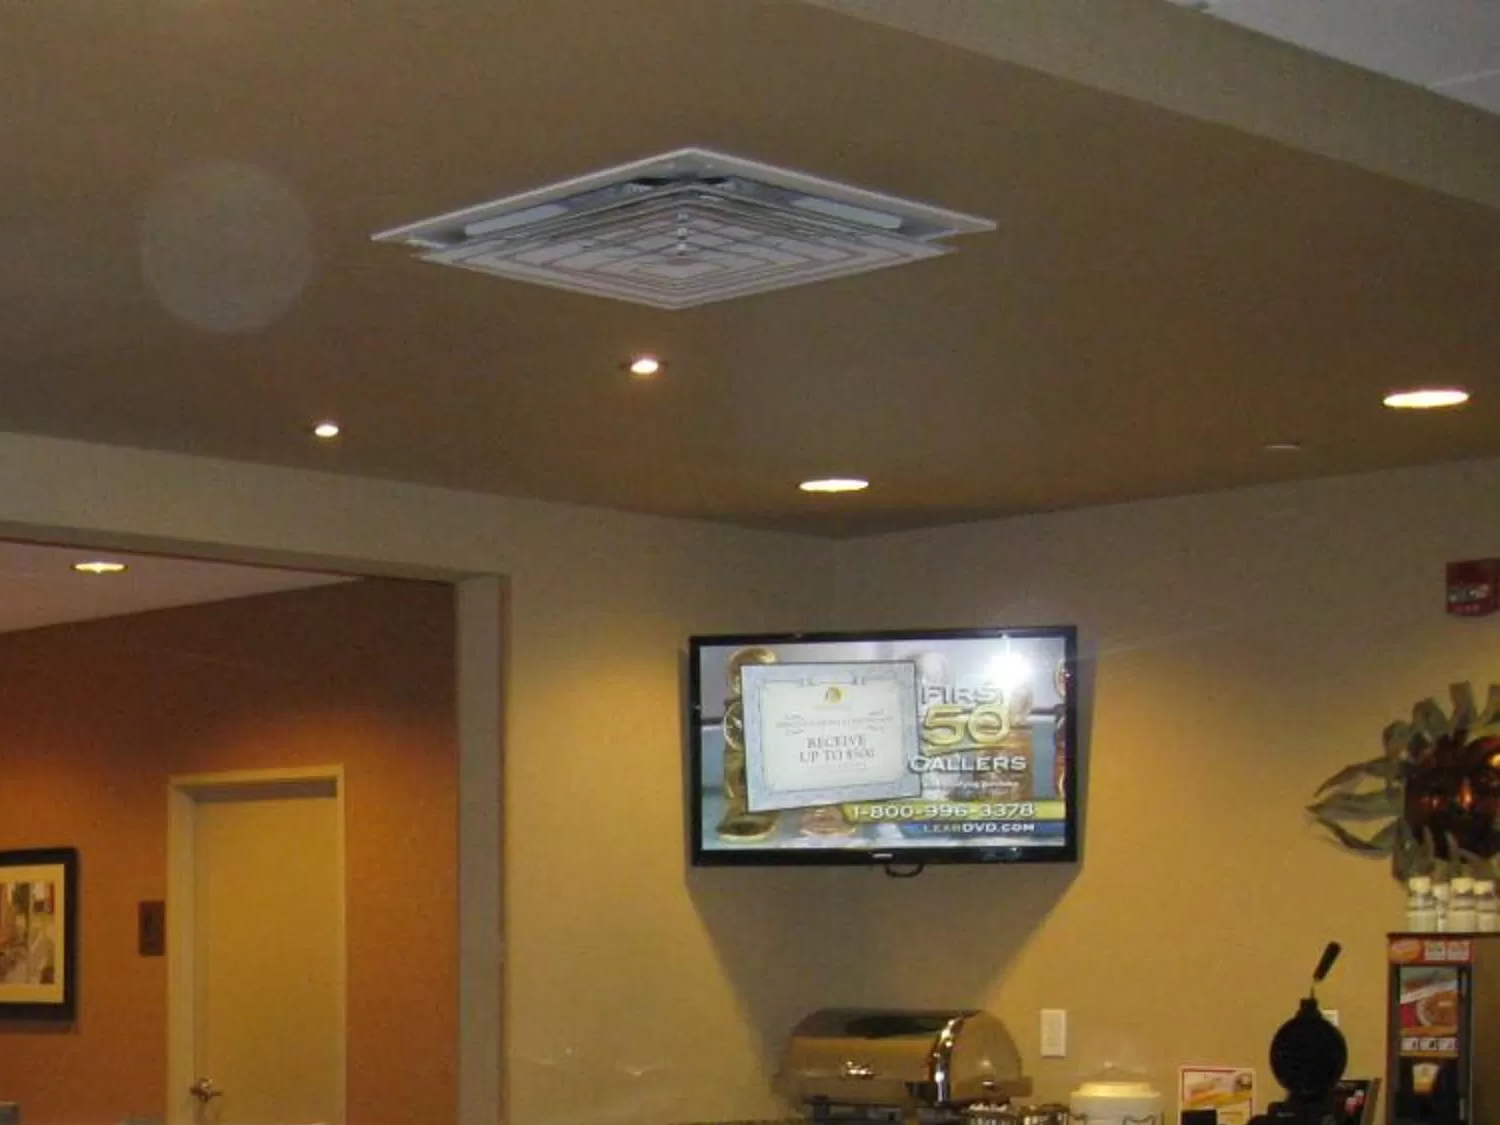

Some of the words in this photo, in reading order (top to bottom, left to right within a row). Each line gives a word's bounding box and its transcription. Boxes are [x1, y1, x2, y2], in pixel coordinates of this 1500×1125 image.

[924, 704, 1010, 745] 50
[807, 734, 866, 749] RECEIVE
[799, 750, 819, 763] UP
[822, 749, 843, 762] TO
[909, 756, 1027, 772] CALLERS
[854, 803, 1035, 819] 1-800-996-3378
